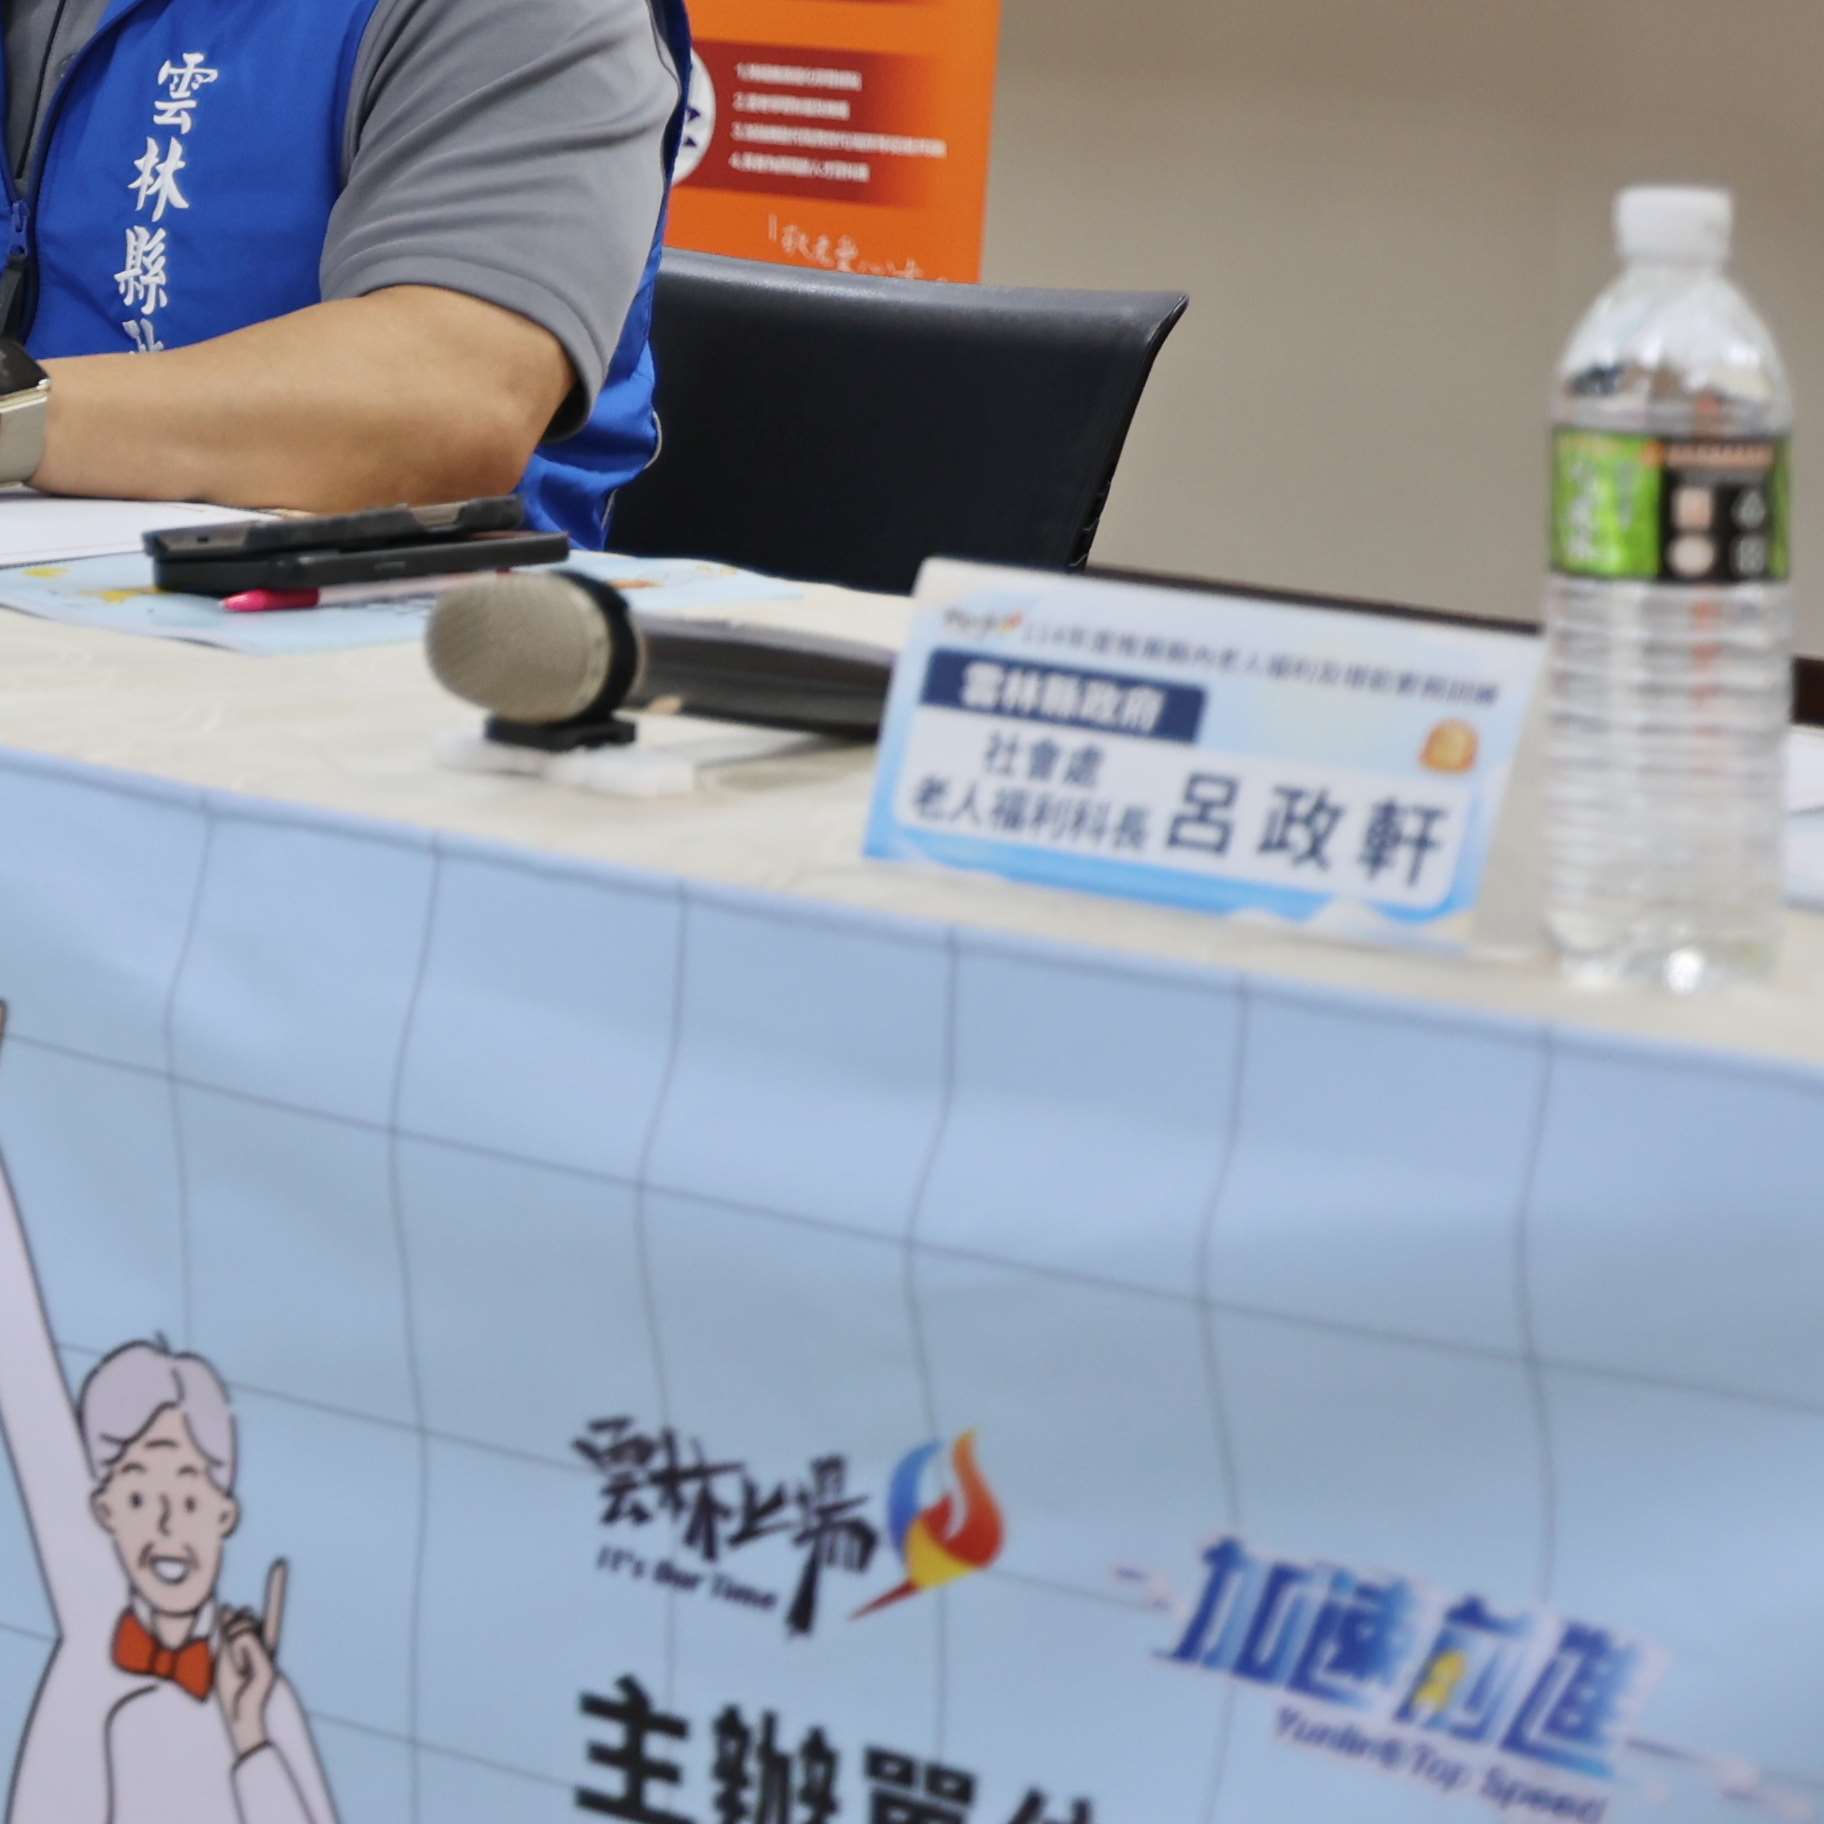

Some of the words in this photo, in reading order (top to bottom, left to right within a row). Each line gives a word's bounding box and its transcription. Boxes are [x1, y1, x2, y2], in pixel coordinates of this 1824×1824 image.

[960, 662, 1167, 732] 雲林縣政府
[985, 732, 1105, 789] 社會處
[912, 777, 1150, 850] 老人福利科長
[1165, 771, 1447, 880] 呂政軒
[573, 1674, 1098, 1824] 主辦單
